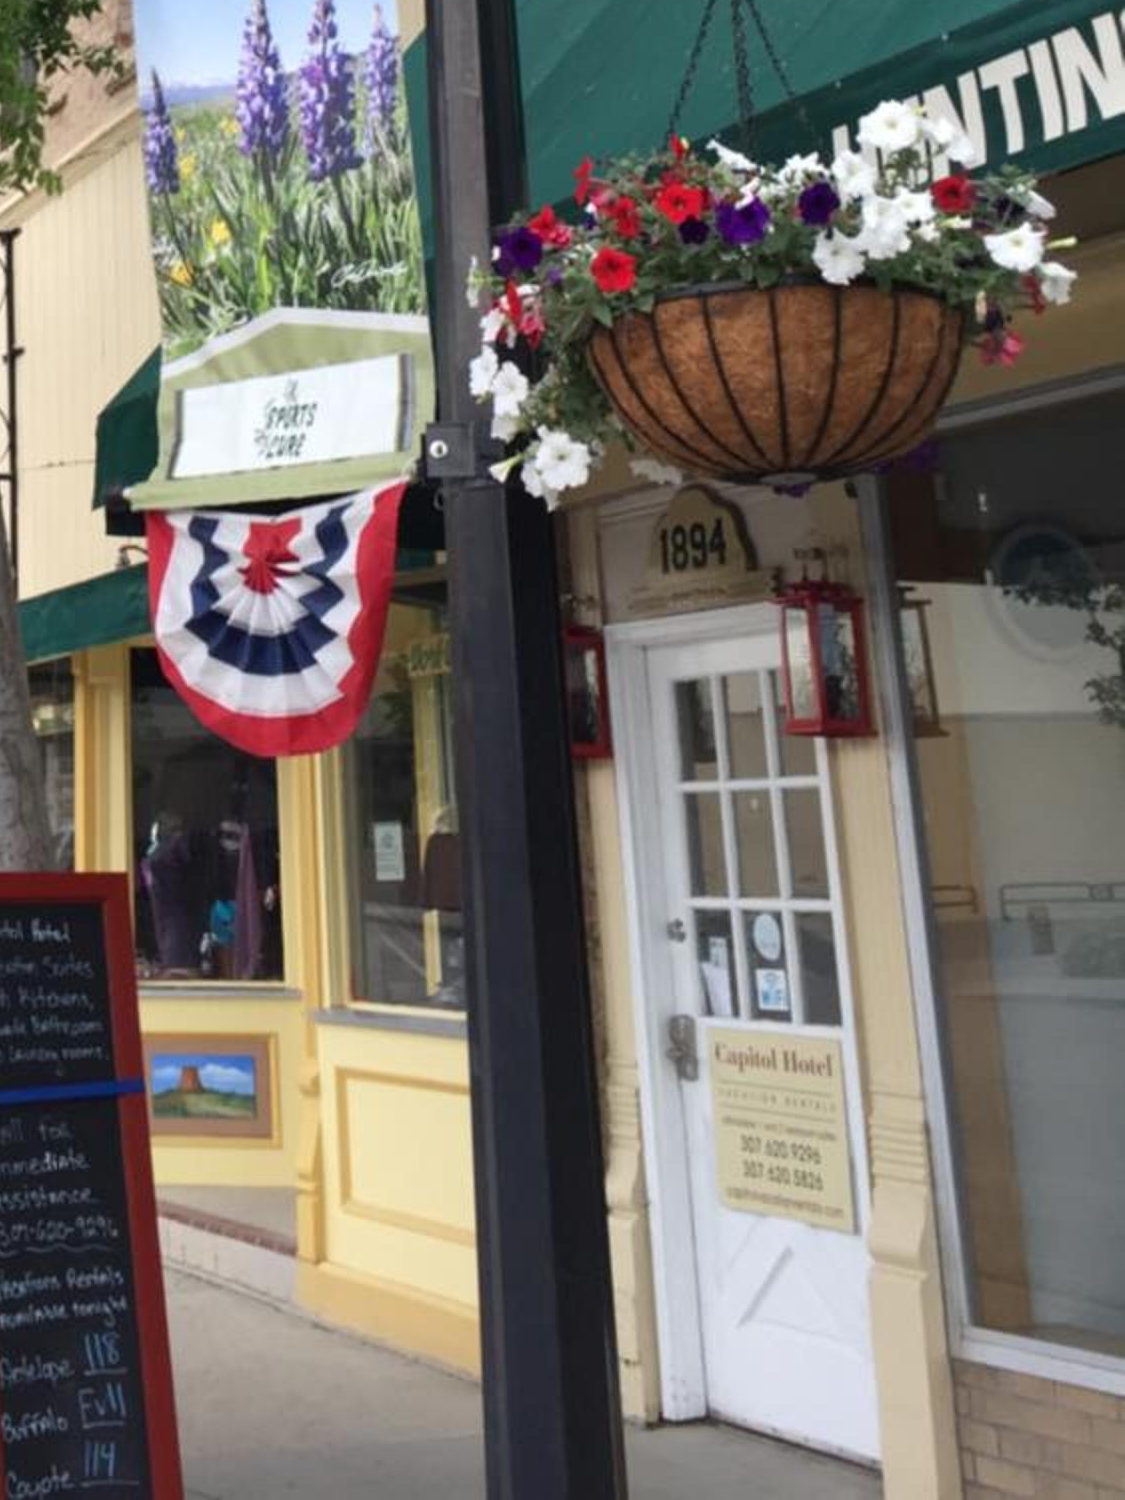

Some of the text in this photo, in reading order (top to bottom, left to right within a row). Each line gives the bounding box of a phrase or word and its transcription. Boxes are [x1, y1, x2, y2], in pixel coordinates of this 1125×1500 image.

[659, 517, 725, 575] 1894
[714, 1042, 833, 1077] Capitol Hotel
[83, 1331, 122, 1371] 118
[83, 1441, 117, 1479] 114
